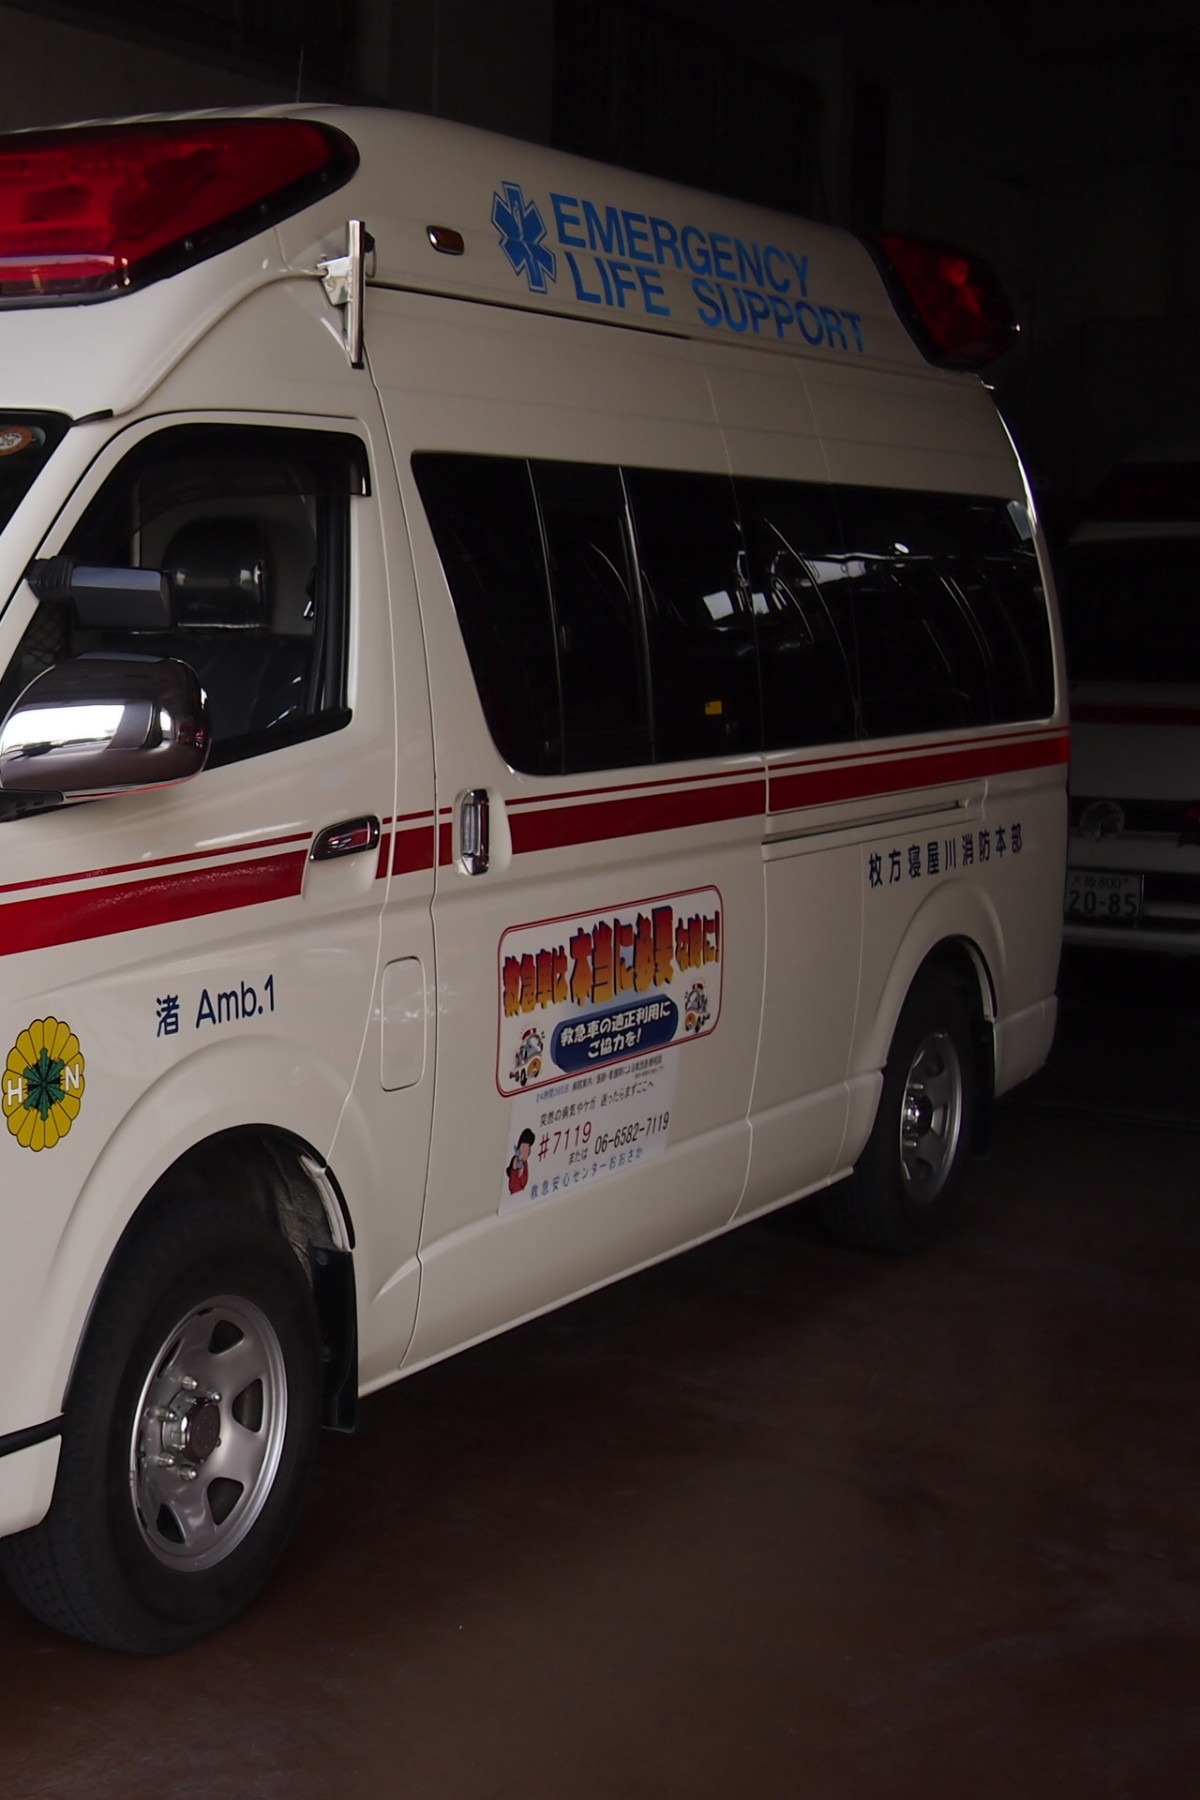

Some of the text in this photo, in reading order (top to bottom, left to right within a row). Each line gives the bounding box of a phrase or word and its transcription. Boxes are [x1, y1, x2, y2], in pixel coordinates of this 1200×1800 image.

[550, 193, 809, 296] EMERGENCY
[564, 252, 864, 352] LIFE SUPPORT
[868, 824, 1023, 888] 枚方寝屋川消防本部
[1068, 890, 1137, 917] 20-85
[156, 974, 275, 1037] 渚 Amb.1
[561, 1001, 671, 1047] 救急車の適正利用に
[587, 1028, 641, 1058] ご協力を!
[7, 1077, 24, 1105] H
[64, 1064, 80, 1091] N
[537, 1121, 592, 1162] #7119
[594, 1111, 670, 1155] 06-6582-7119
[568, 1148, 588, 1166] または
